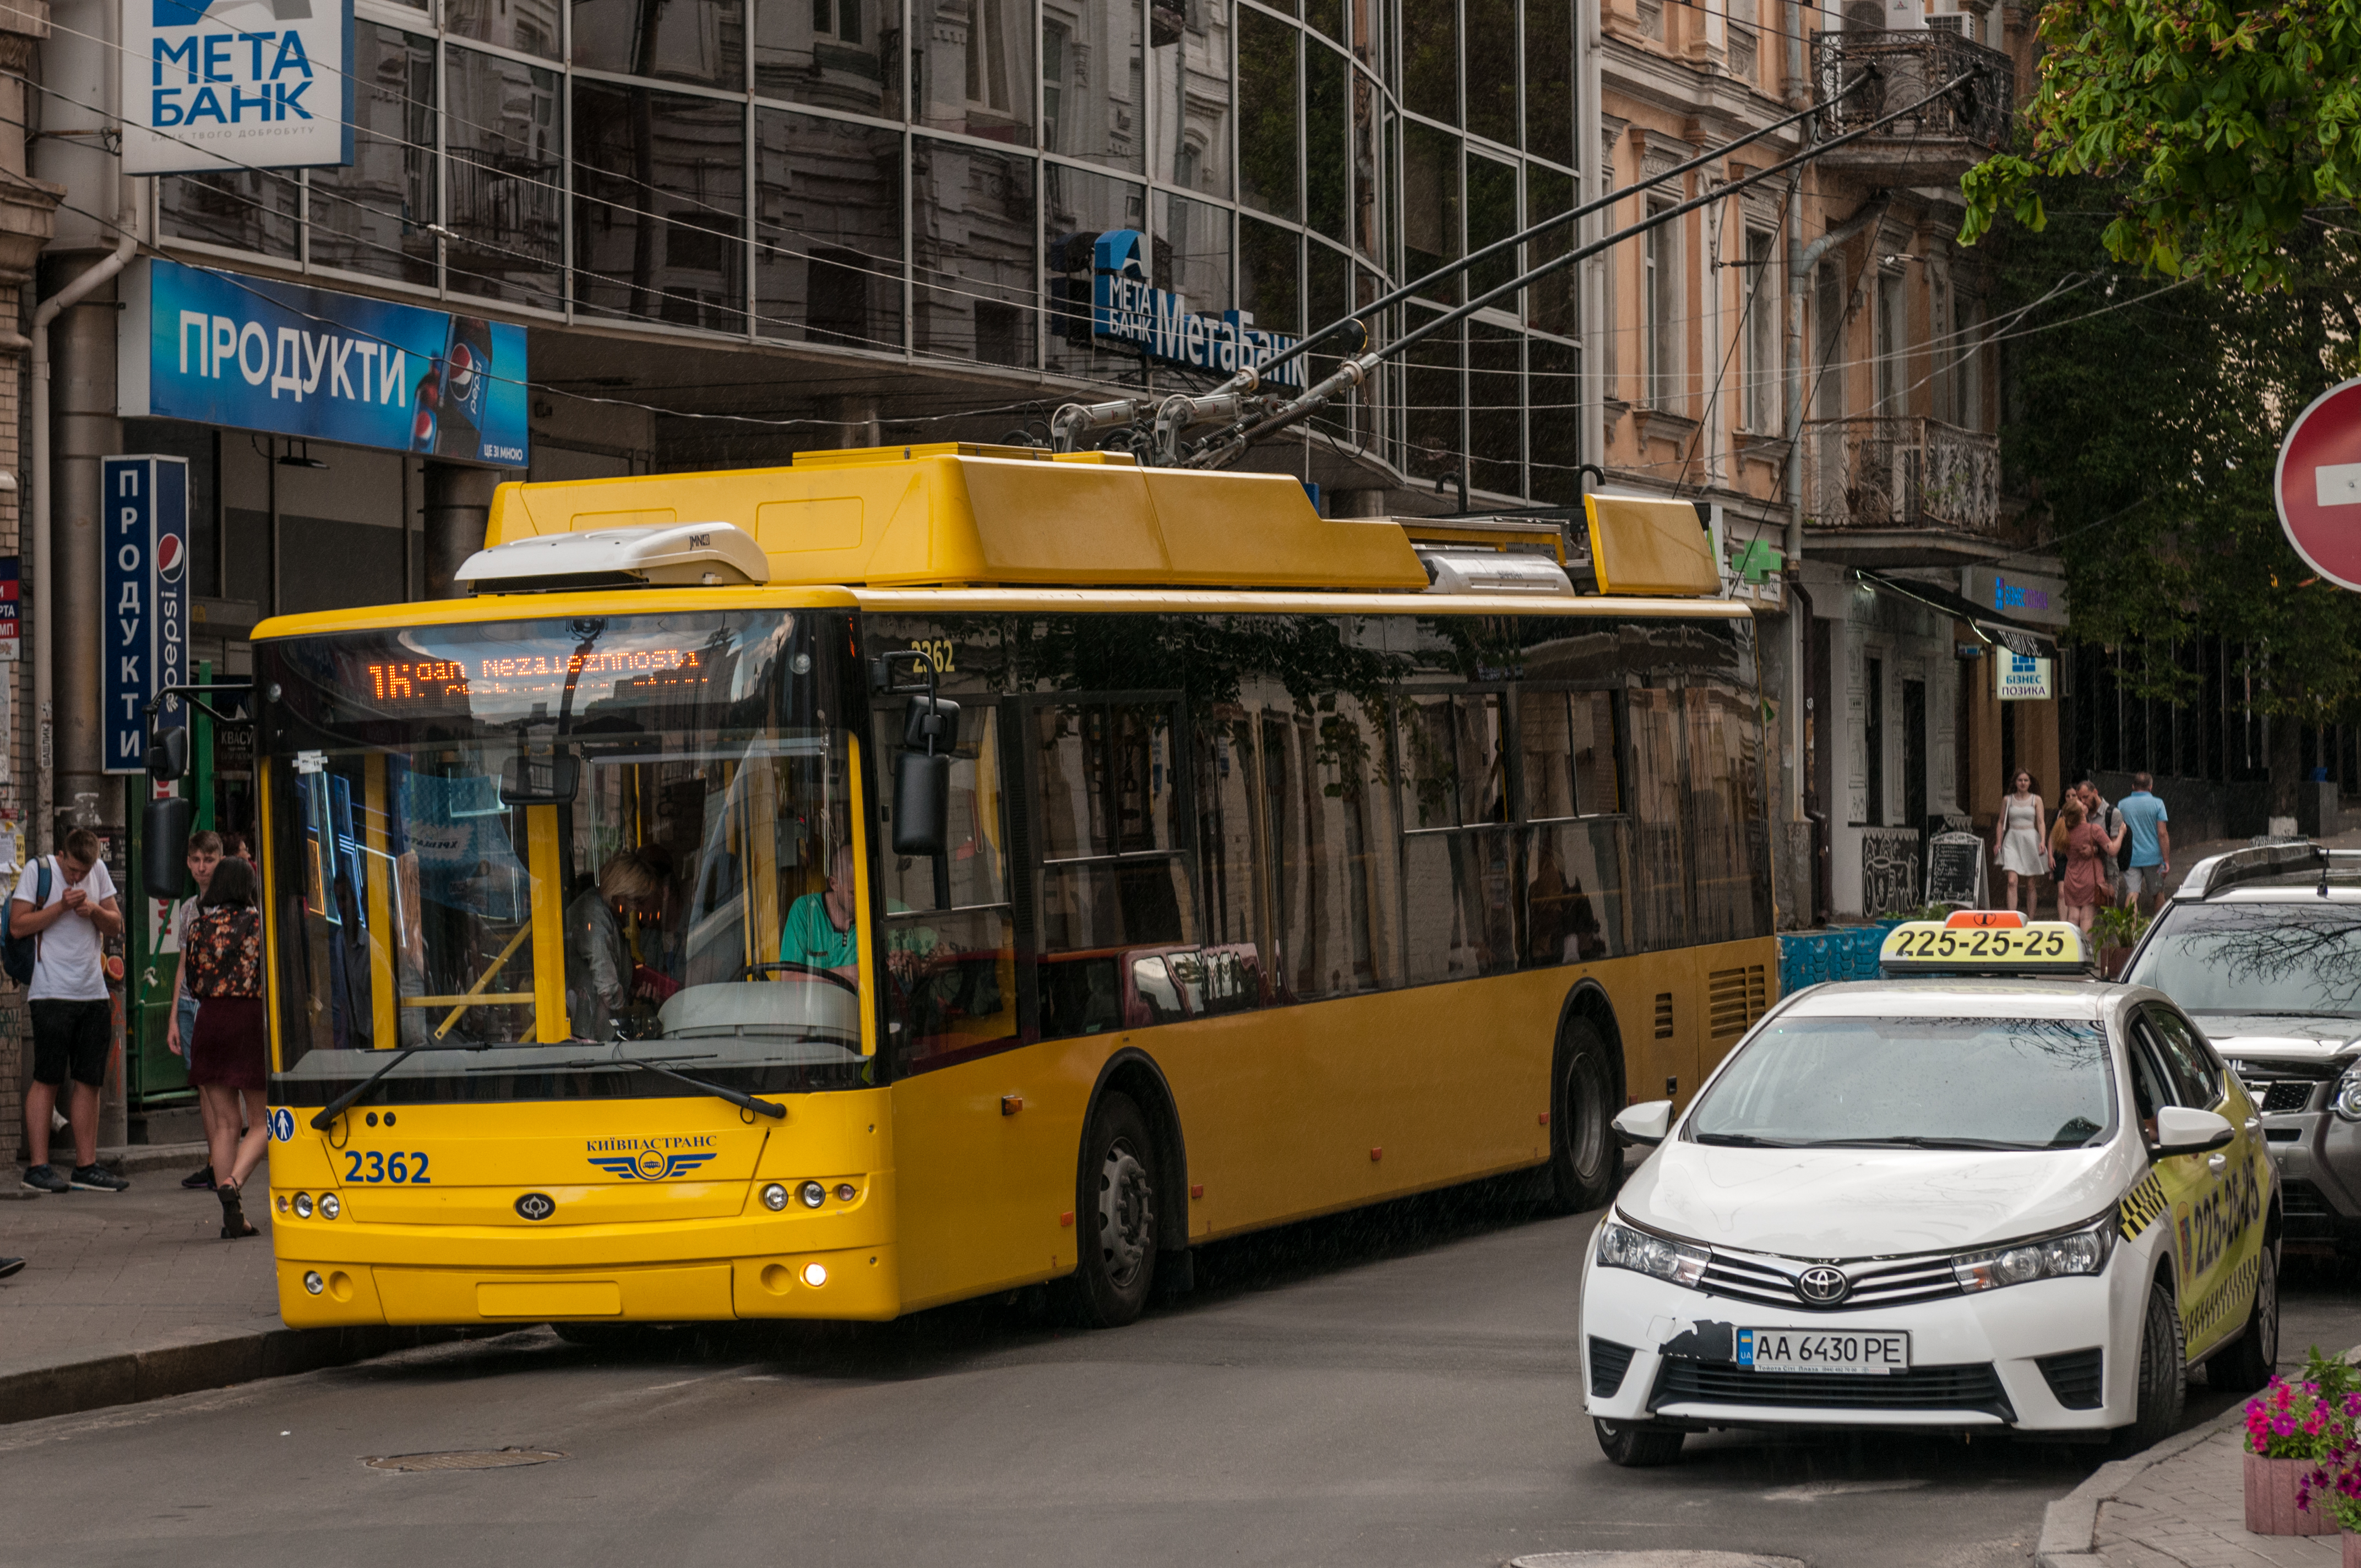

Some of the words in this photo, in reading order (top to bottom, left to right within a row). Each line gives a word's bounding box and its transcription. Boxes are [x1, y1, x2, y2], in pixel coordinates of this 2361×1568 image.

[153, 30, 313, 86] МЕТА
[153, 81, 313, 127] БАНК
[192, 130, 232, 139] ТВОГО
[238, 126, 314, 138] ДОБРОБУТУ
[1109, 275, 1151, 317] МЕТА
[1109, 309, 1152, 343] БАНК
[1157, 288, 1305, 388] МетаБанк
[179, 309, 406, 407] ПРОДУКТИ
[471, 360, 482, 415] pepsi
[484, 444, 493, 458] ЦЕ
[493, 445, 499, 458] ЗІ
[500, 447, 523, 461] МНОЮ
[118, 470, 140, 758] ПРОДУКТИ
[161, 590, 181, 691] pepsi
[911, 640, 955, 673] 2362
[2002, 686, 2045, 695] ПОЗИКА
[2006, 674, 2041, 684] БІЗНЕС
[1896, 930, 2064, 957] 225-25-25
[587, 1135, 717, 1151] КИЇВПАСТРАНС
[345, 1150, 431, 1183] 2362
[2194, 1153, 2260, 1280] 225-25-25
[1756, 1336, 1791, 1360] AA
[1799, 1336, 1857, 1362] 6430
[1864, 1338, 1901, 1363] PE
